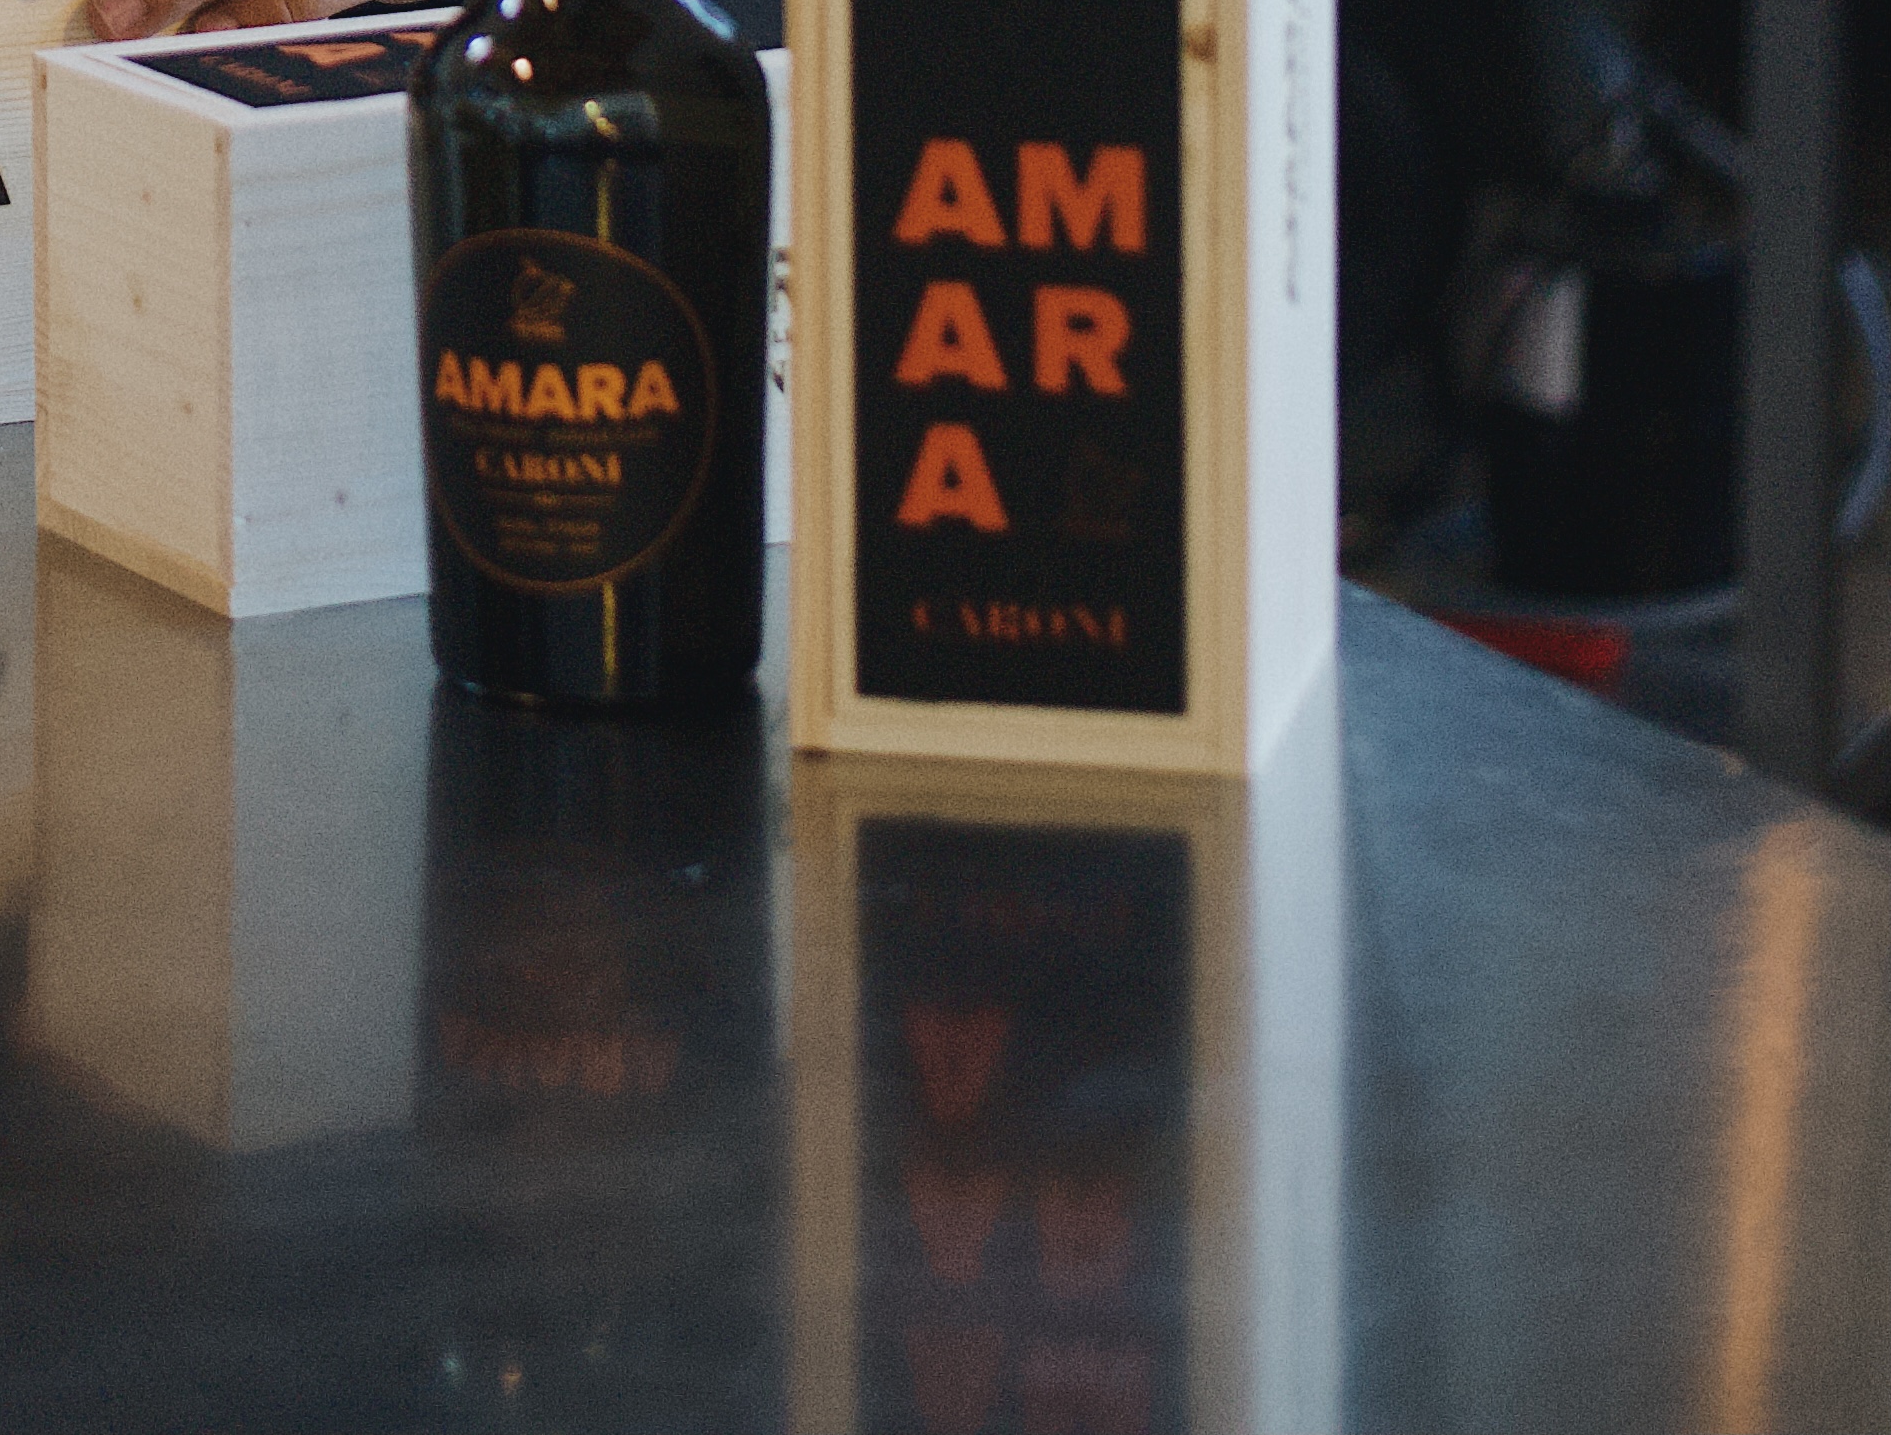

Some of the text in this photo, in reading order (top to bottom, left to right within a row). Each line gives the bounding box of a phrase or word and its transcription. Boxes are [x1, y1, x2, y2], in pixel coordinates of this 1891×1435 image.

[892, 138, 1147, 254] AM
[435, 348, 681, 424] AMARA
[893, 280, 1132, 396] AR
[894, 421, 1010, 534] A
